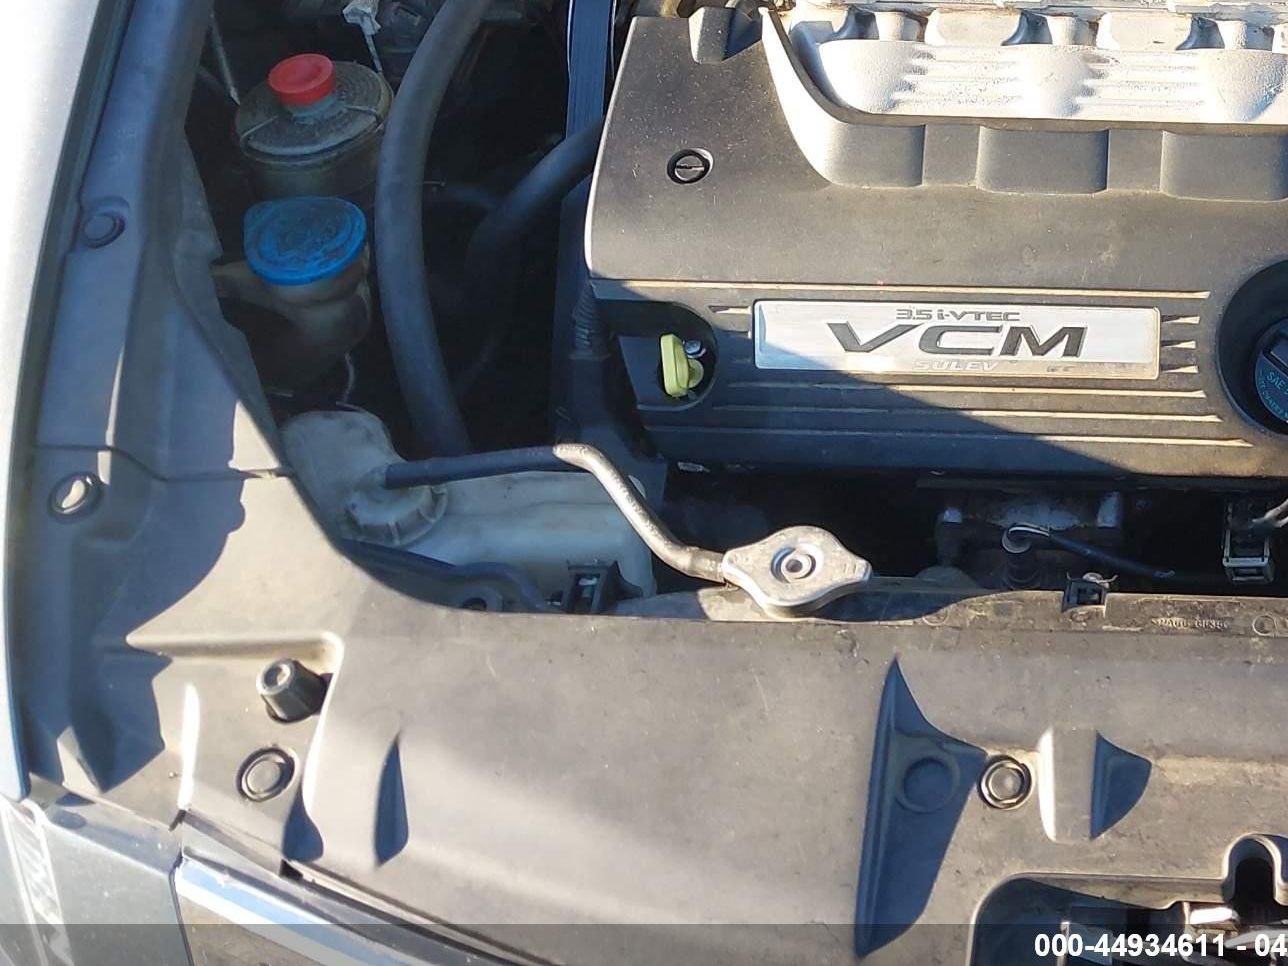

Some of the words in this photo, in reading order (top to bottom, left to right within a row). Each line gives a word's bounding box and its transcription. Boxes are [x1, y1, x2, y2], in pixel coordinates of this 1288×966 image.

[895, 308, 933, 320] 3.5
[937, 310, 1022, 322] i-VTEC
[826, 320, 1089, 358] VCM
[912, 359, 998, 371] SULEV
[1266, 371, 1285, 390] SAE
